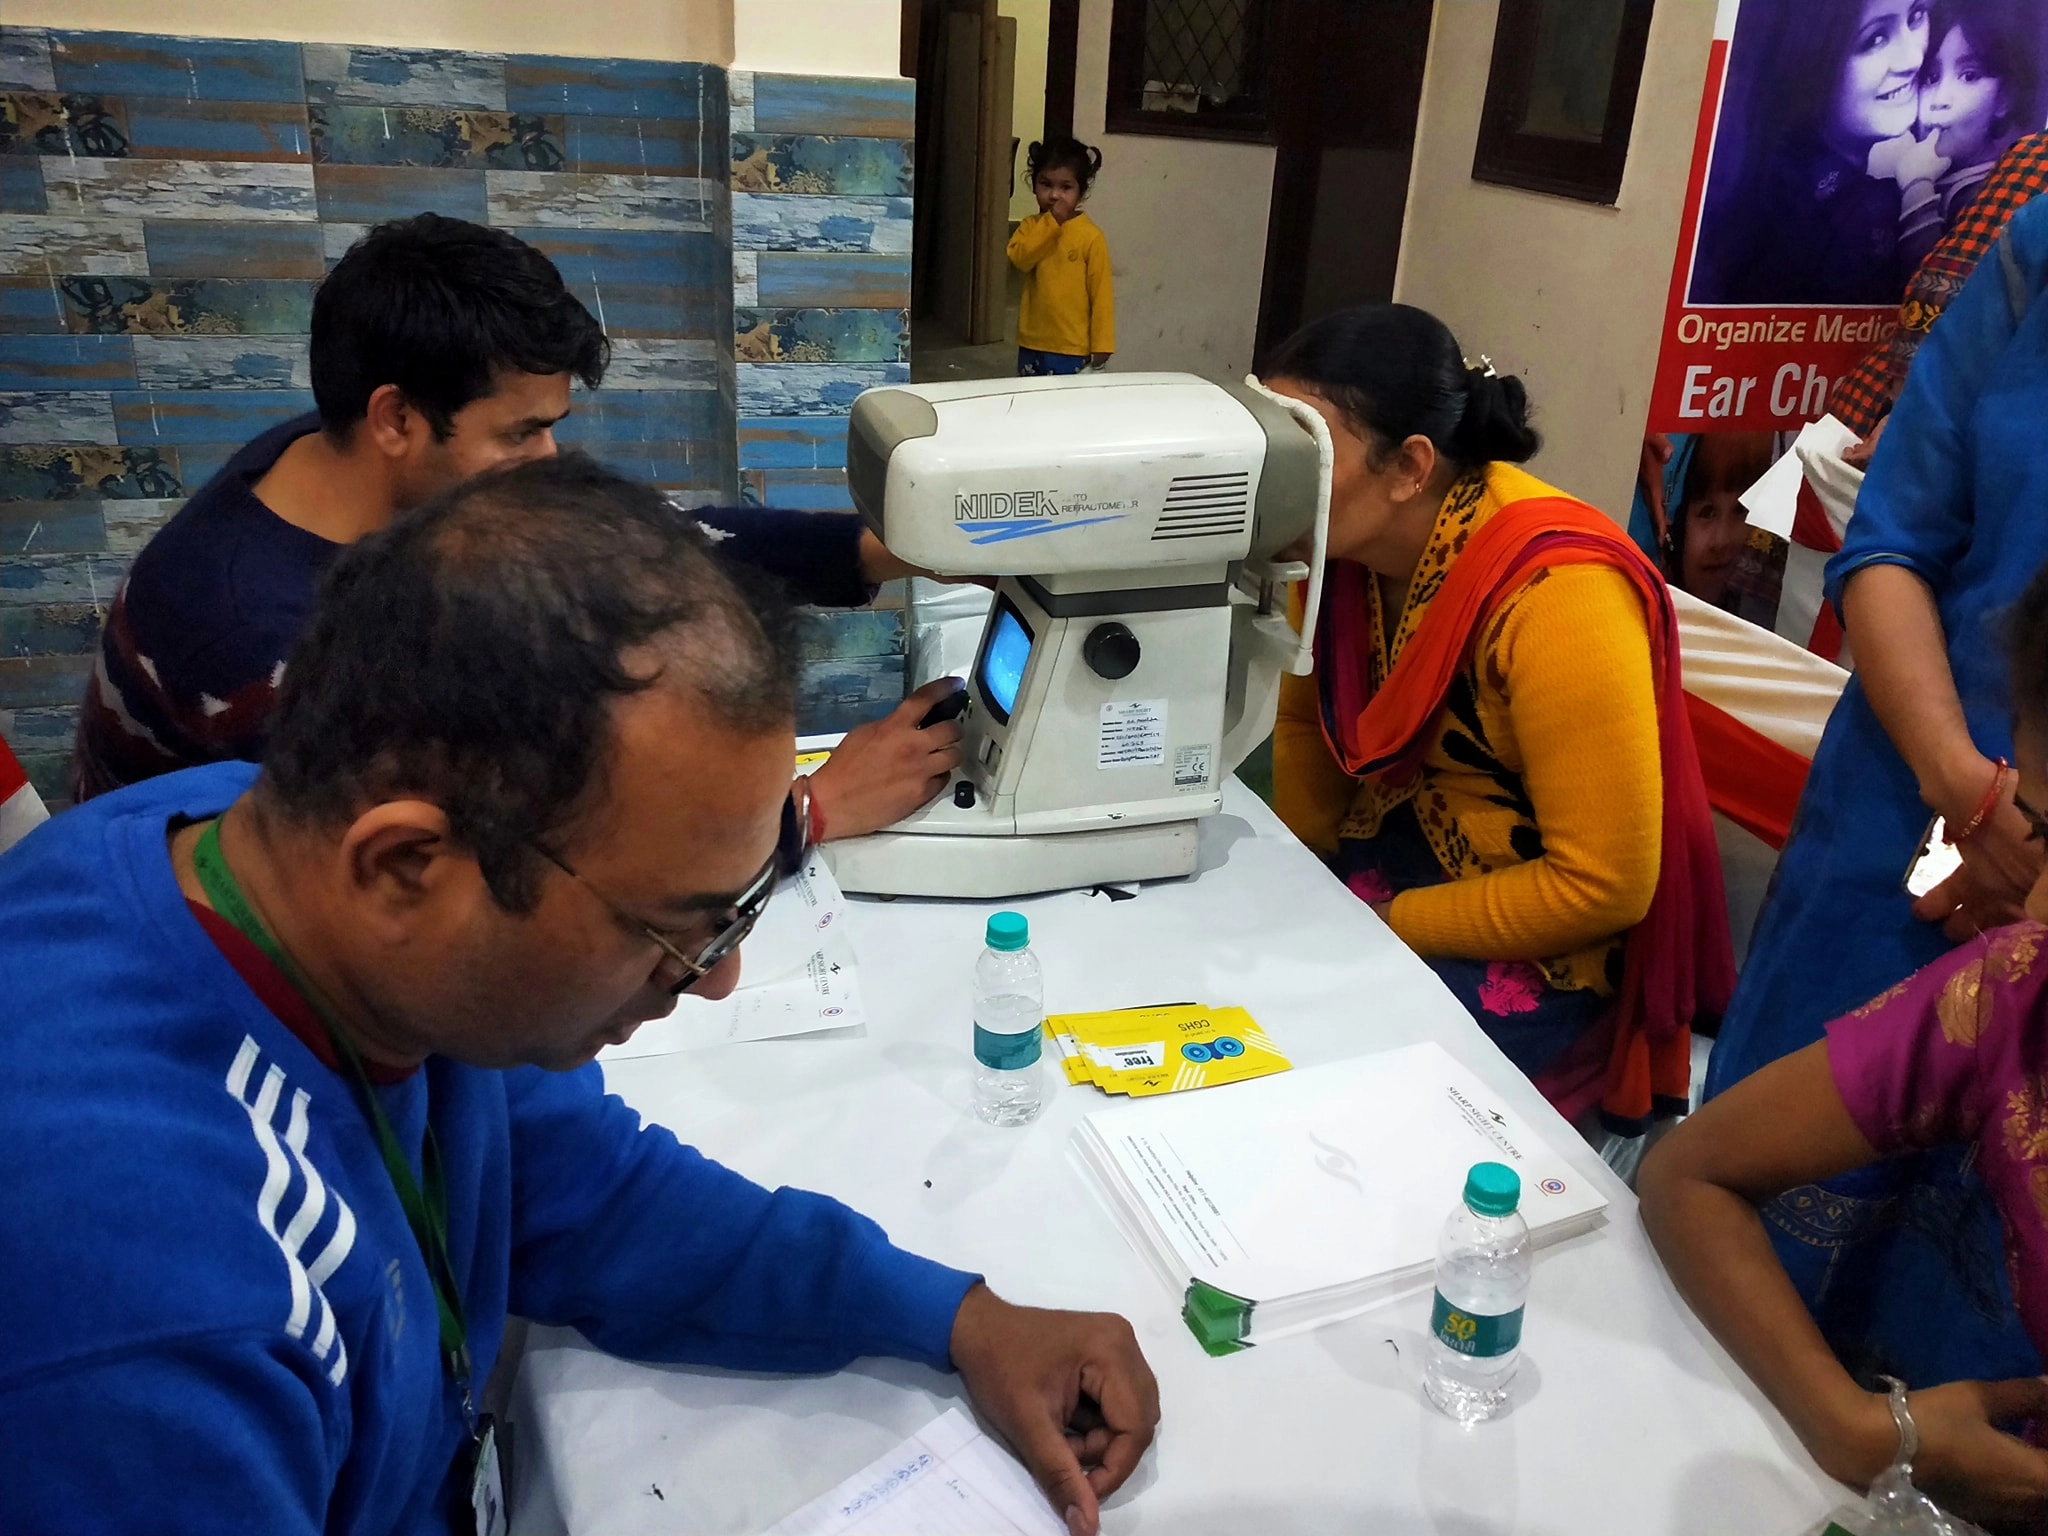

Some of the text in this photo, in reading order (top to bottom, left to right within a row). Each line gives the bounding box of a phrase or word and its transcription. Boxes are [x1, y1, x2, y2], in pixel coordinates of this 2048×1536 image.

[1678, 314, 1807, 350] Organize
[1678, 362, 1846, 418] Ear Ch
[955, 490, 1058, 521] NIDEK
[1177, 1019, 1211, 1032] CGHS
[1447, 1086, 1473, 1110] SHARP
[1469, 1107, 1495, 1130] SIGHT
[1492, 1130, 1524, 1160] CENTRE
